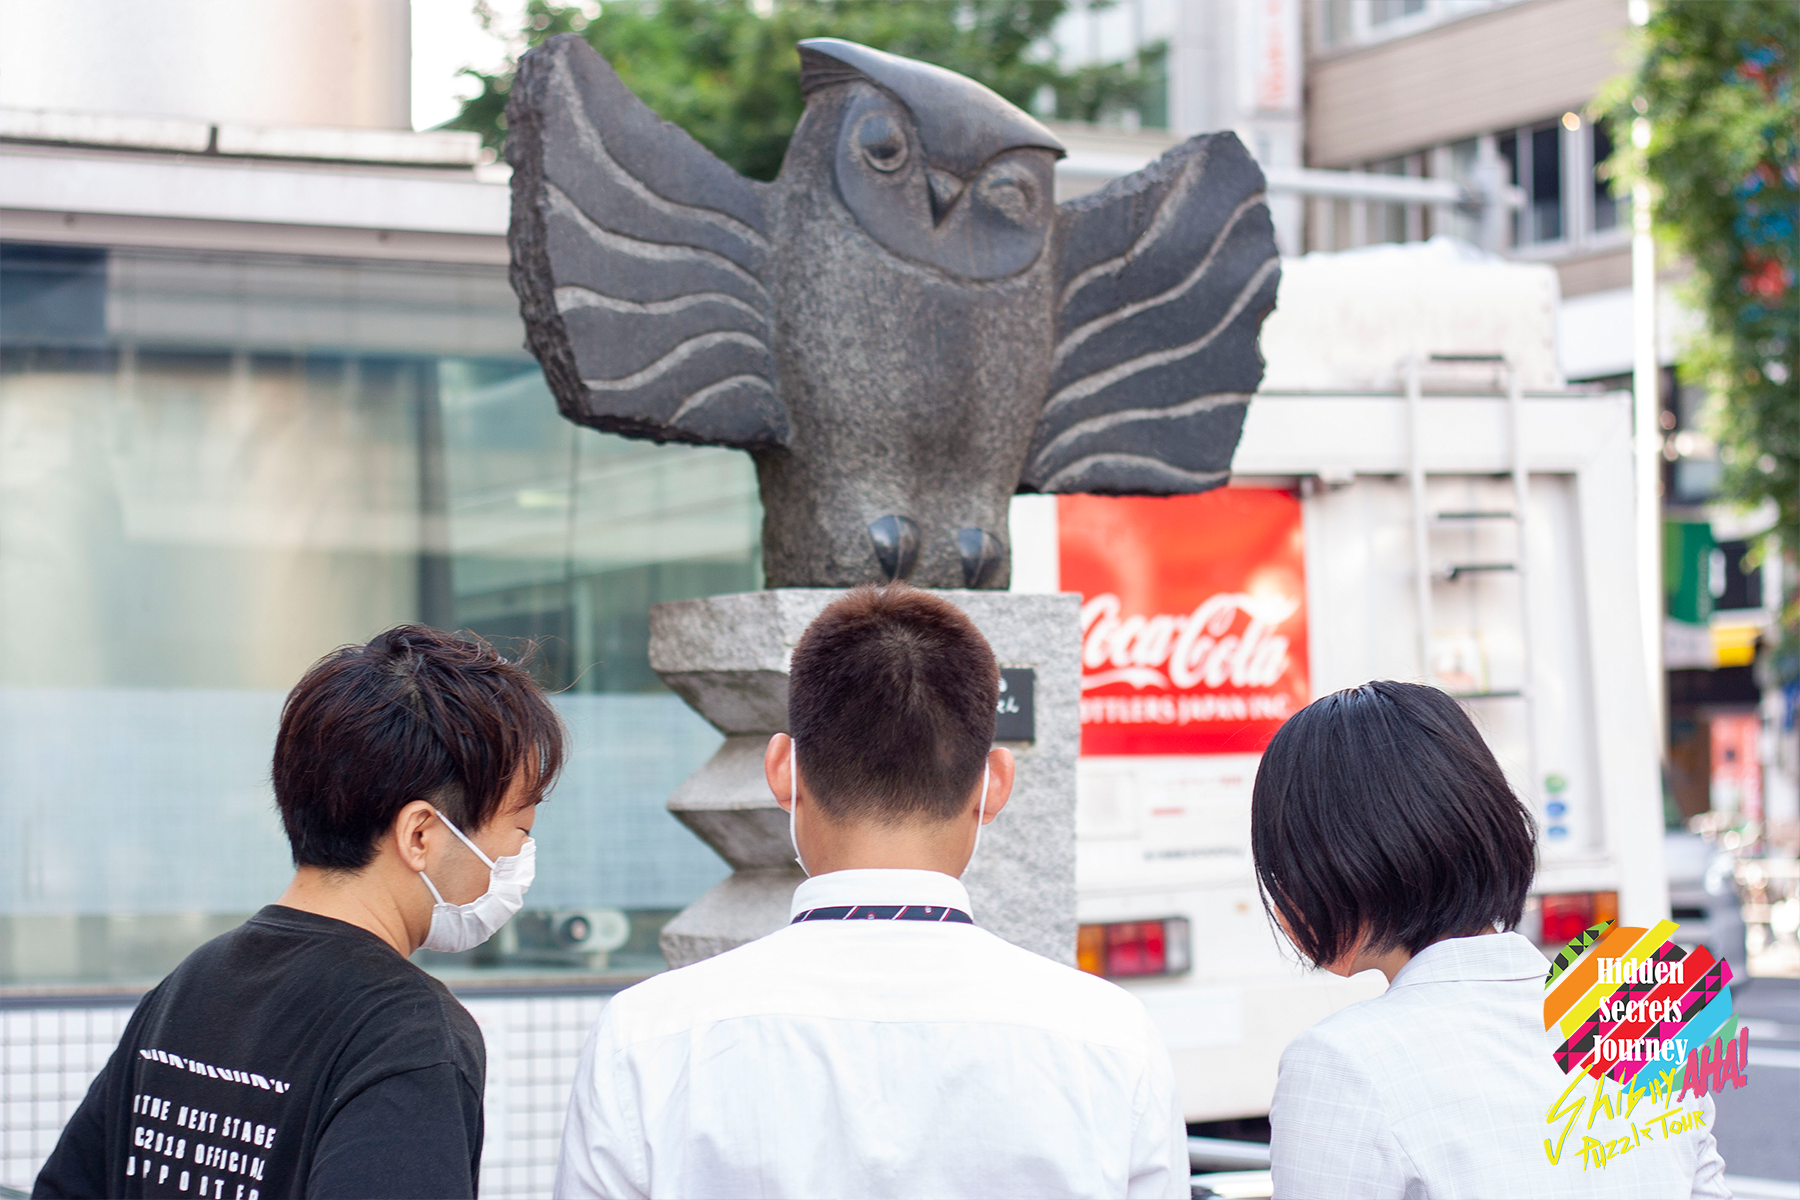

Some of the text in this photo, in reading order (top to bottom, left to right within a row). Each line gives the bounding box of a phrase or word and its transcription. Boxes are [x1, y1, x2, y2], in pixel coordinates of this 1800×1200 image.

[1177, 693, 1247, 726] JAPAN
[176, 1105, 218, 1134] NEXT
[221, 1116, 277, 1150] STAGE
[194, 1143, 266, 1182] OFFICIAL
